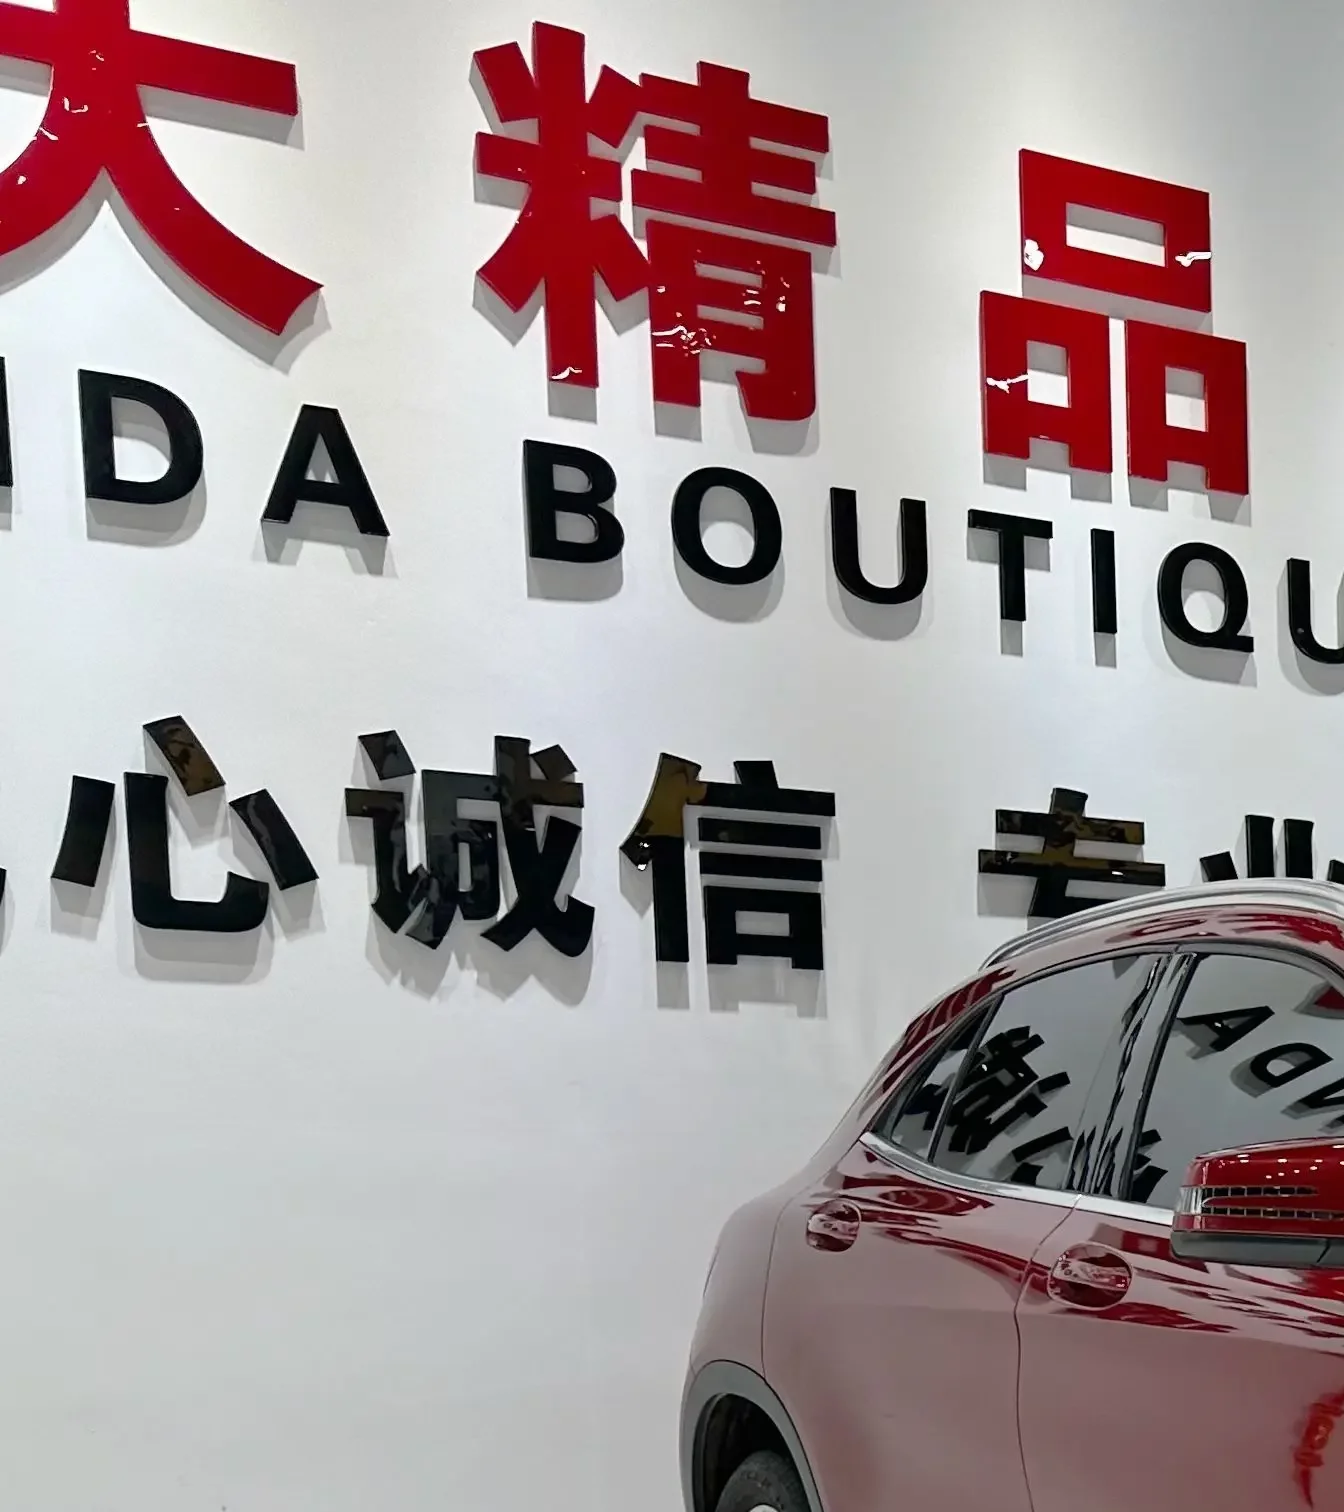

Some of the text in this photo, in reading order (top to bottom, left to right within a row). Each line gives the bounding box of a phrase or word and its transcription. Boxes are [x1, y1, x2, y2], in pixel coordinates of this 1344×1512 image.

[0, 357, 390, 538] DA
[0, 715, 836, 971] 心诚信
